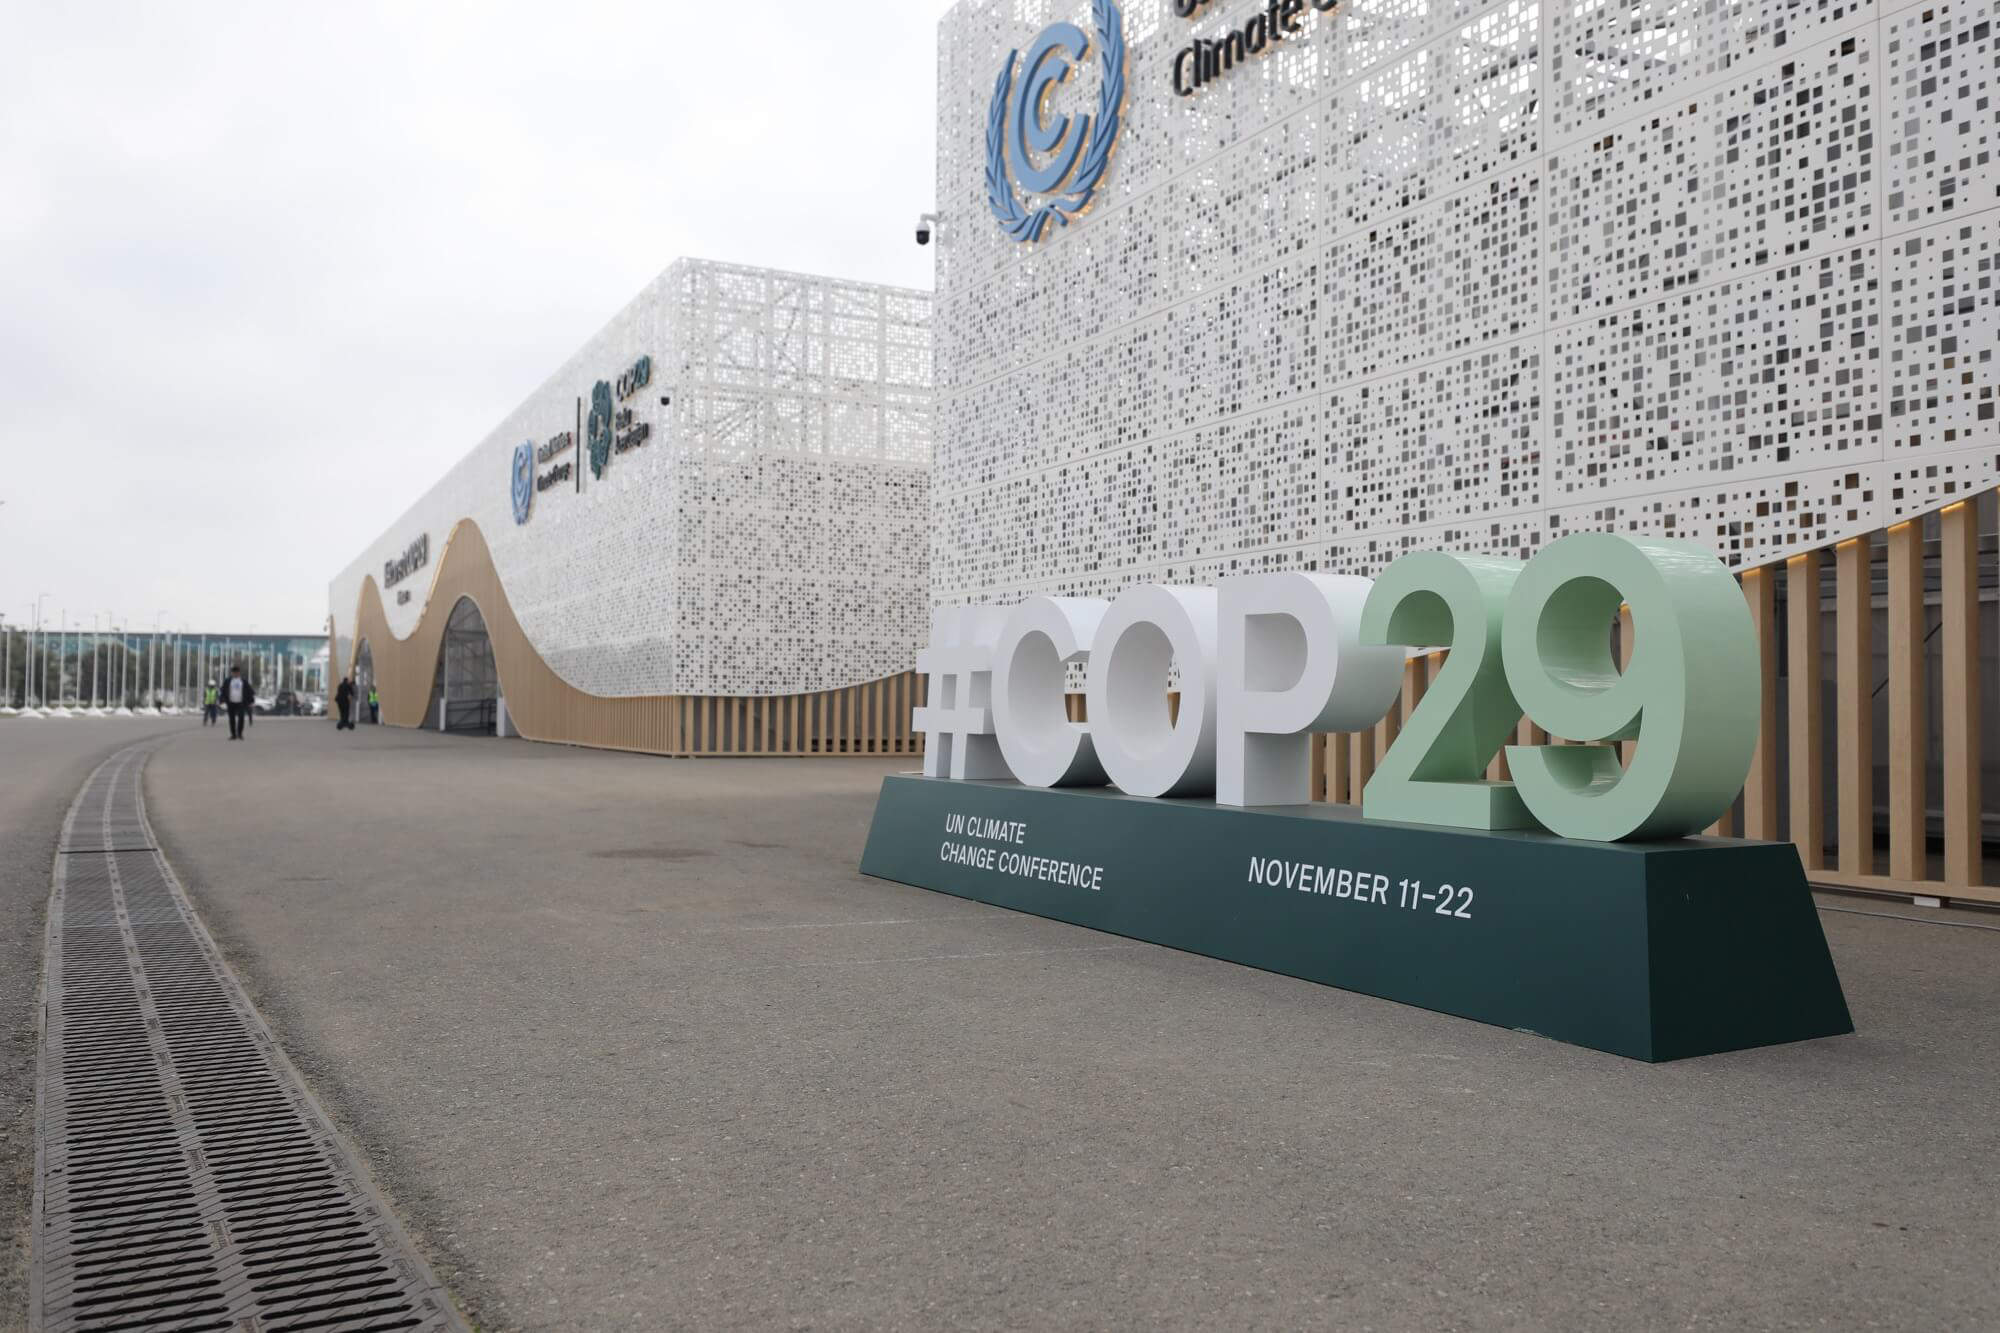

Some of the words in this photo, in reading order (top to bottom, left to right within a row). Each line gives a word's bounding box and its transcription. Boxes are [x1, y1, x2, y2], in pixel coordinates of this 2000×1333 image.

[1173, 0, 1303, 96] Climate
[912, 530, 1762, 843] #COP29
[945, 813, 965, 835] UN
[967, 816, 1027, 845] CLIMATE
[940, 841, 996, 870] CHANGE
[998, 851, 1104, 891] CONFERENCE
[1248, 856, 1390, 905] NOVEMBER
